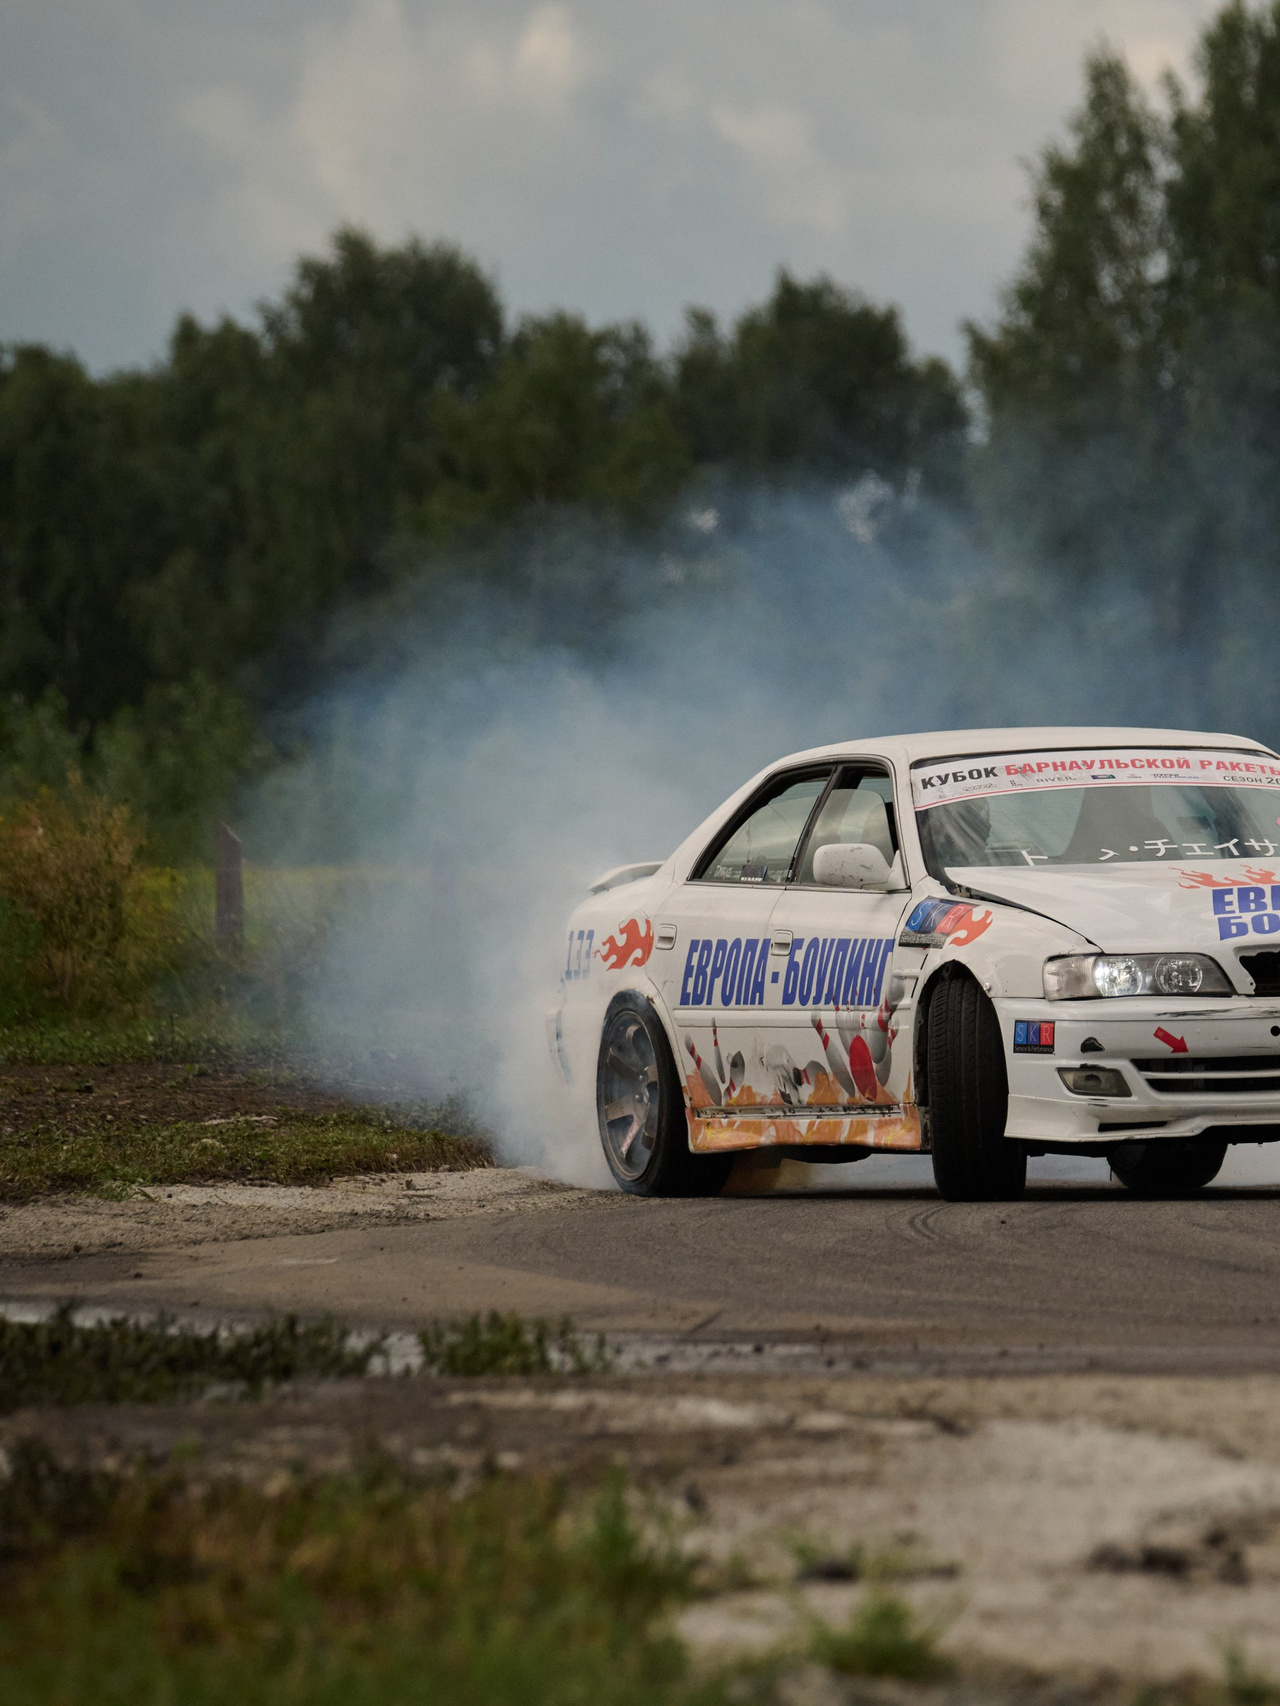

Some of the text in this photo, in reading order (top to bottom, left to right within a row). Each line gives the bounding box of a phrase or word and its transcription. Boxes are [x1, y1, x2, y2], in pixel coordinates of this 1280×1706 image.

[920, 765, 1000, 790] КУБОК
[1004, 757, 1191, 776] БАРНАУЛЬСКОЙ
[1223, 775, 1263, 784] СЕЗОН
[910, 901, 965, 929] SKR
[565, 929, 595, 981] 133
[1017, 1024, 1051, 1043] SKR
